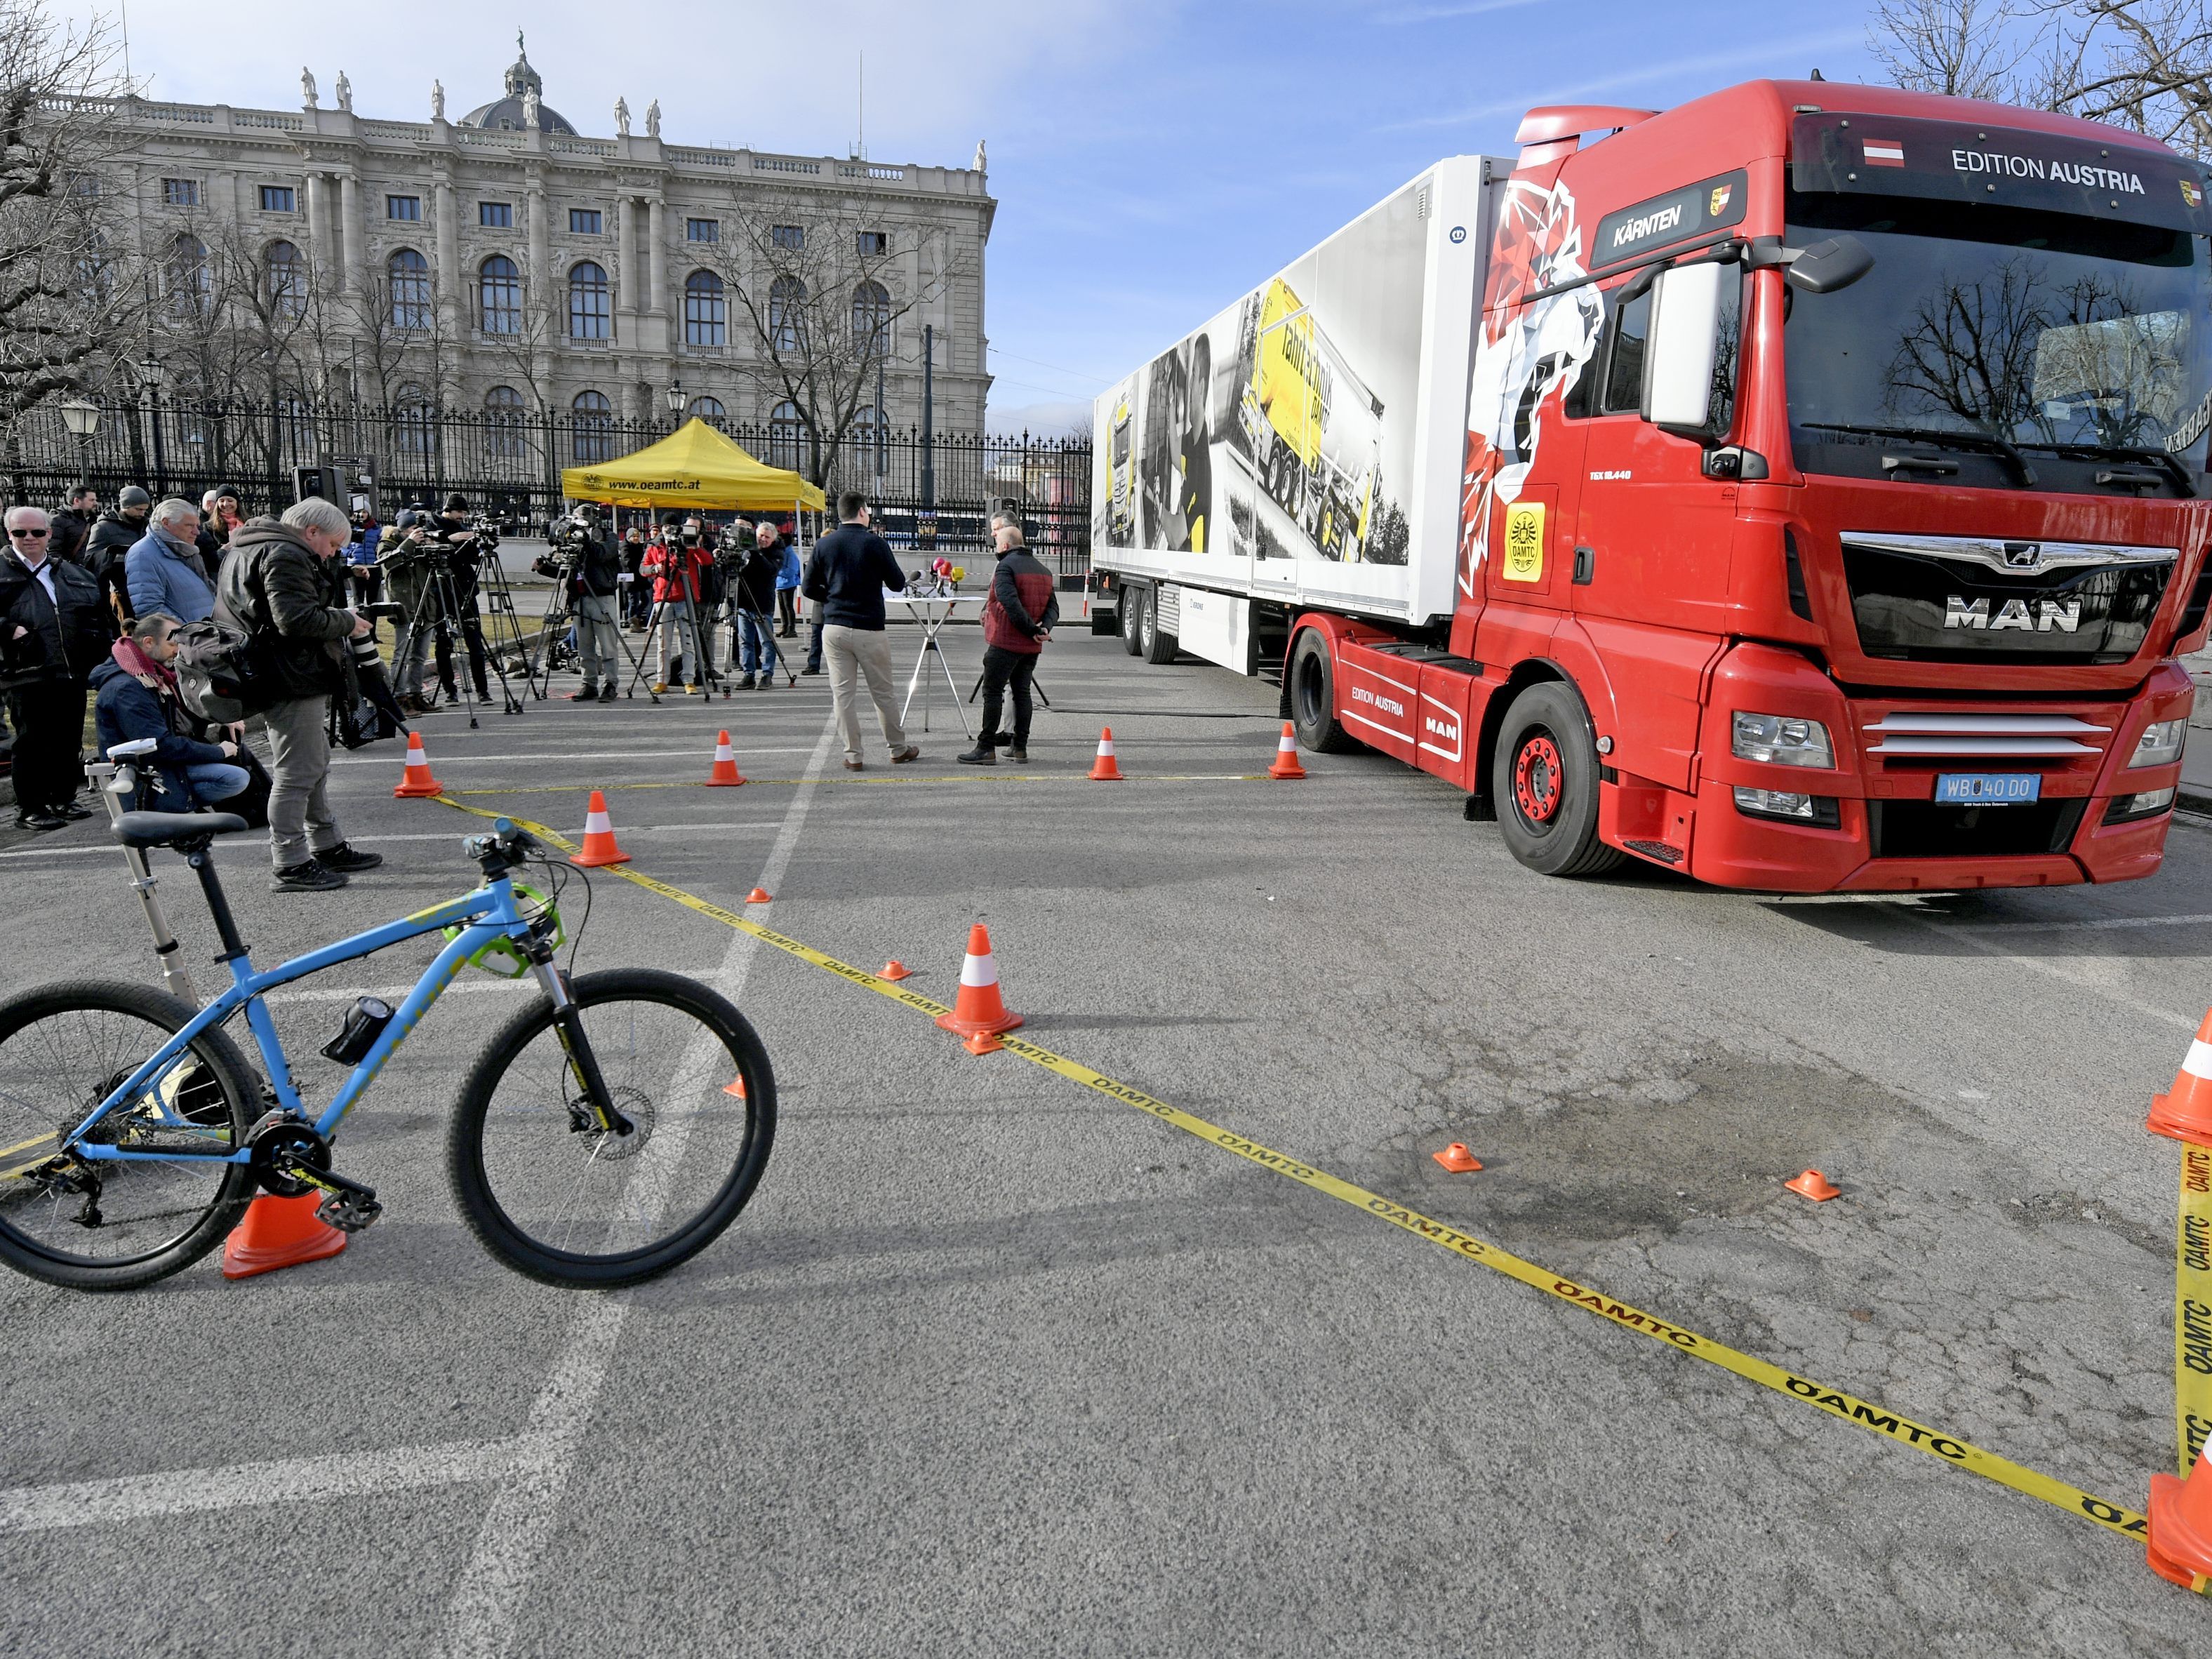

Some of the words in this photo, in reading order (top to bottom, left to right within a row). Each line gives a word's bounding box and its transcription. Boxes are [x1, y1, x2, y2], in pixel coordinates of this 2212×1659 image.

[1951, 149, 2046, 180] EDITION
[2049, 161, 2146, 195] AUSTRIA
[1613, 204, 1681, 248] KÄRNTEN
[608, 478, 701, 491] www.oeamtc.at
[1590, 471, 1604, 481] TGX
[1604, 470, 1632, 480] 18.440
[1943, 597, 2081, 632] MAN
[1352, 686, 1374, 705] EDITION
[1375, 695, 1404, 718] AUSTRIA
[1425, 717, 1457, 741] MAN
[1947, 778, 1971, 797] WB
[899, 992, 950, 1015] ÖAMT
[1553, 1280, 1698, 1347] ÖAMTC
[1785, 1375, 1967, 1460] ÖAMTC
